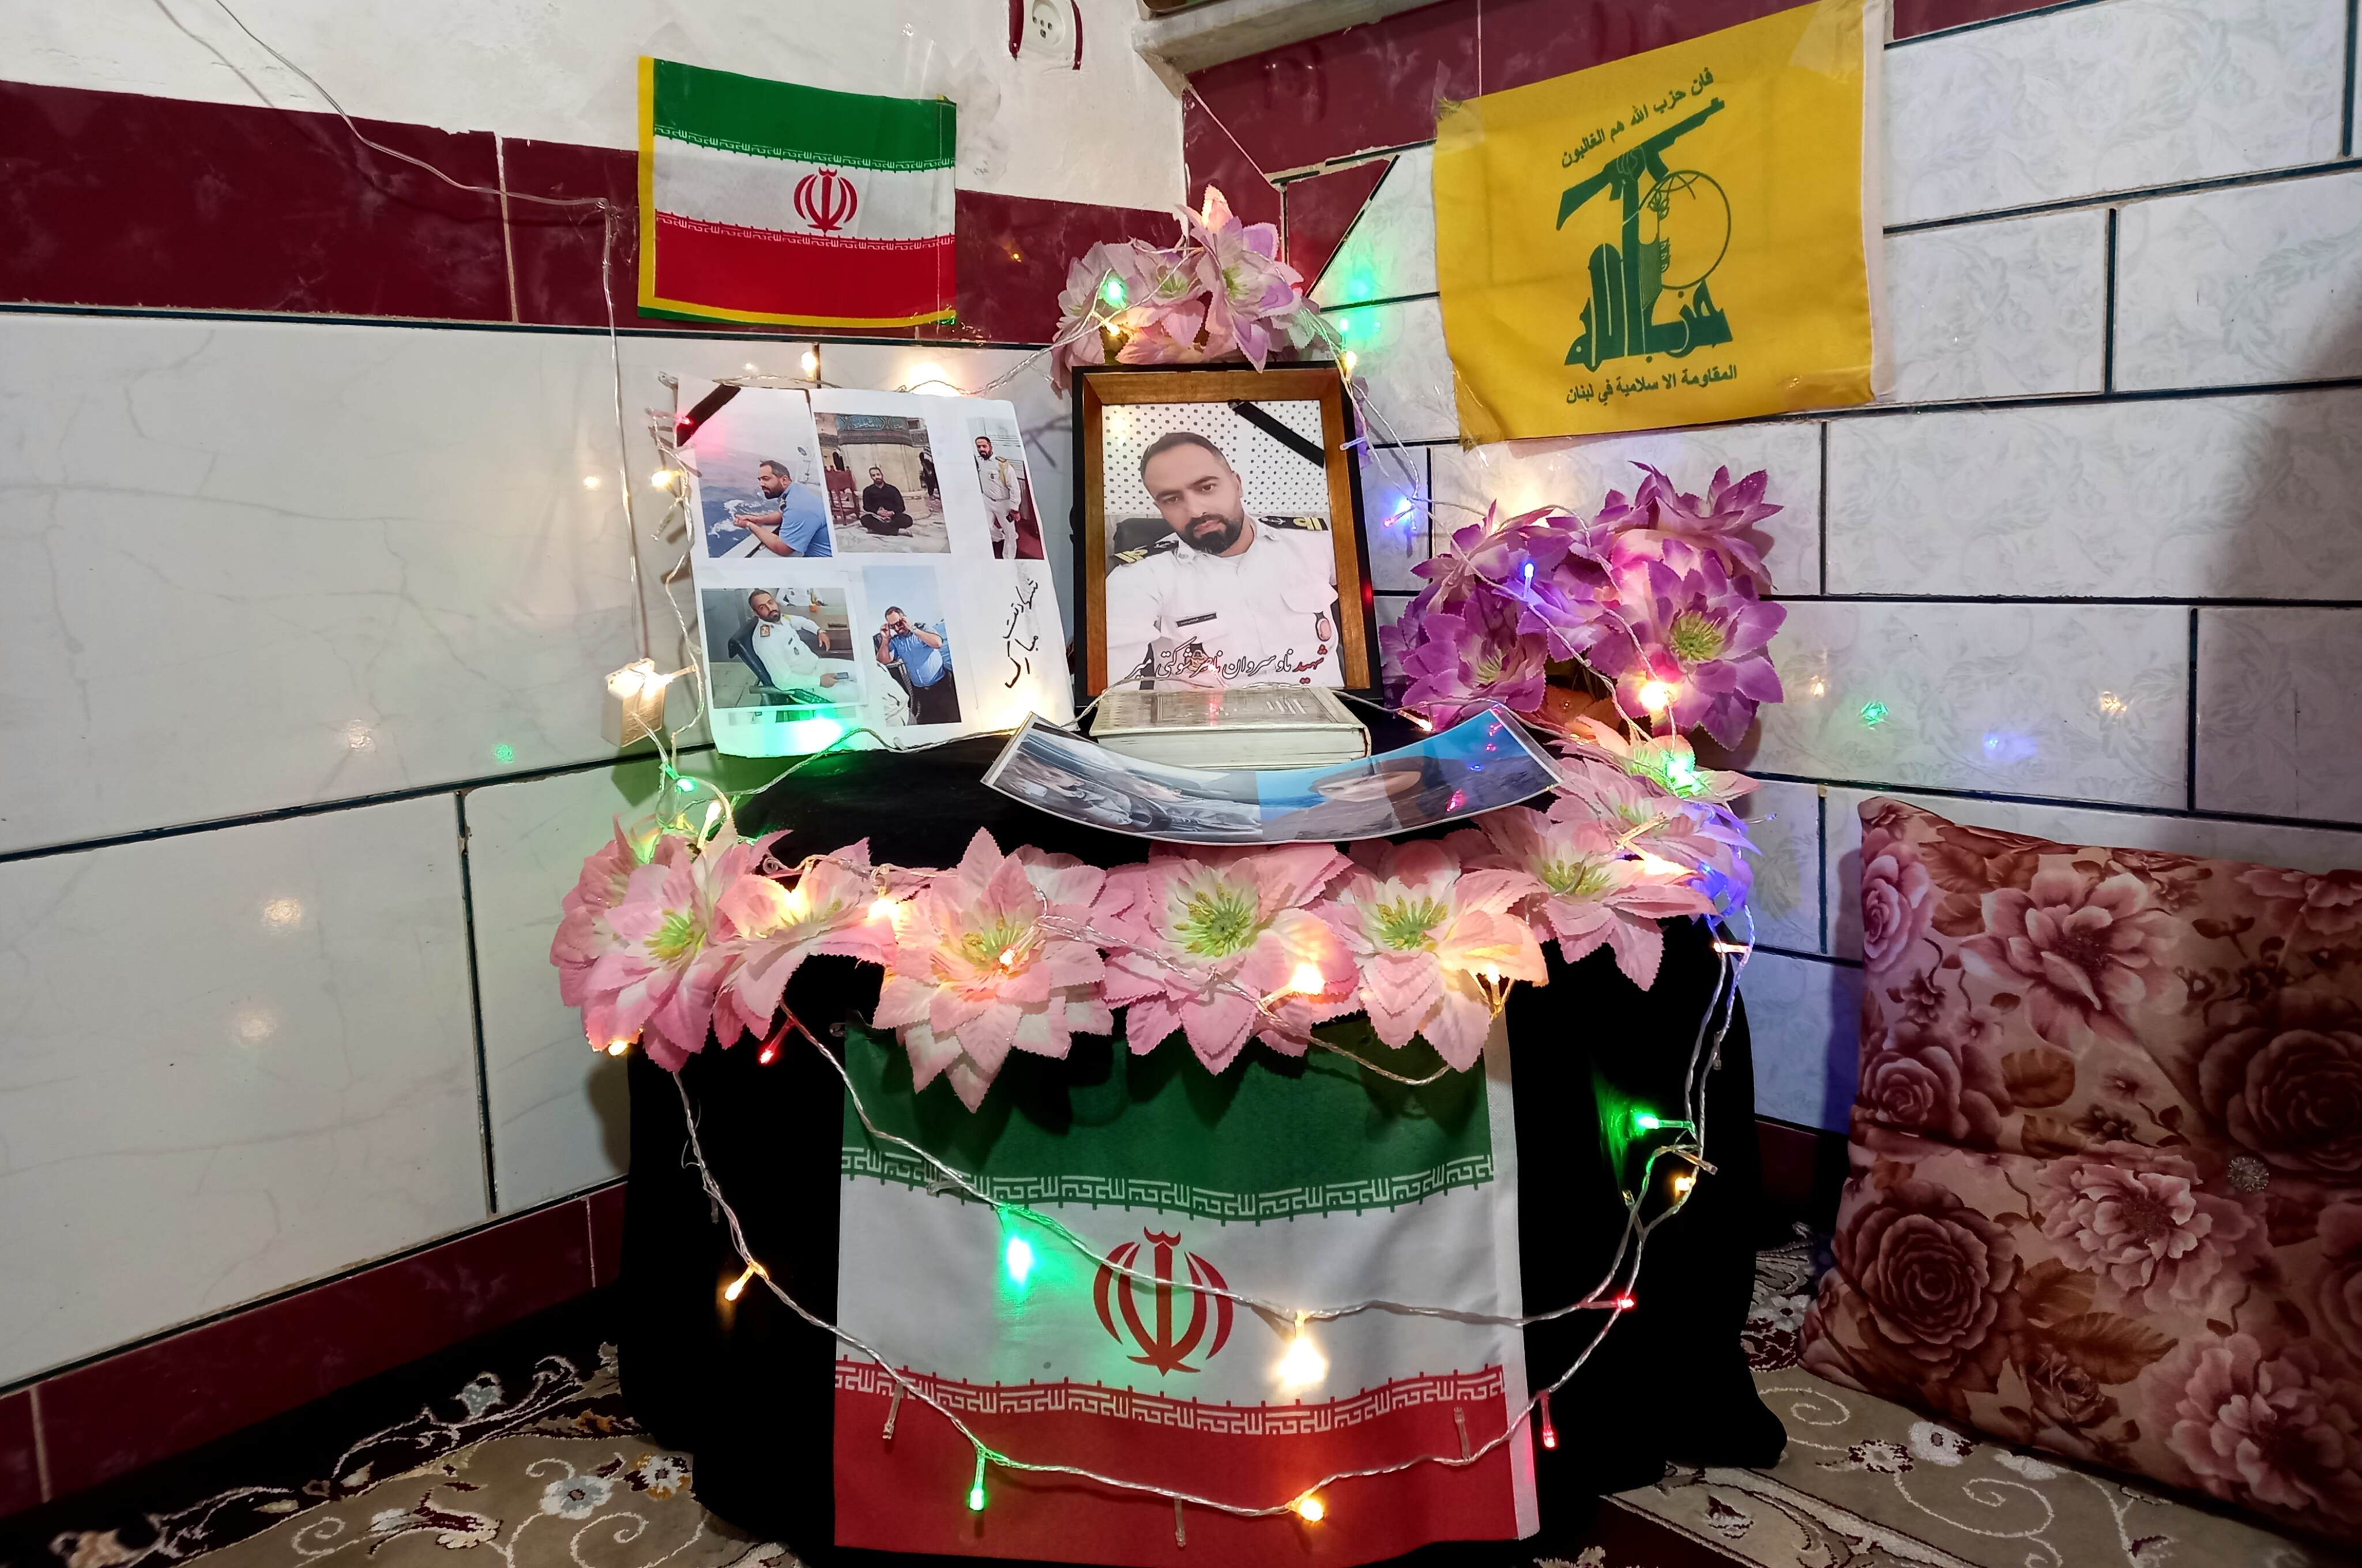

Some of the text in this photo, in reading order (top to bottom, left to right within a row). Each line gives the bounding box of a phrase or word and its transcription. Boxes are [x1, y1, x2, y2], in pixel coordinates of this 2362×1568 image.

[1653, 90, 1686, 114] حزب
[1631, 104, 1649, 125] الله
[1611, 121, 1625, 143] هم
[1562, 128, 1605, 168] الغالبون
[1681, 364, 1737, 388] المقاومة
[1566, 383, 1594, 404] لبنان
[1292, 644, 1328, 685] شهید
